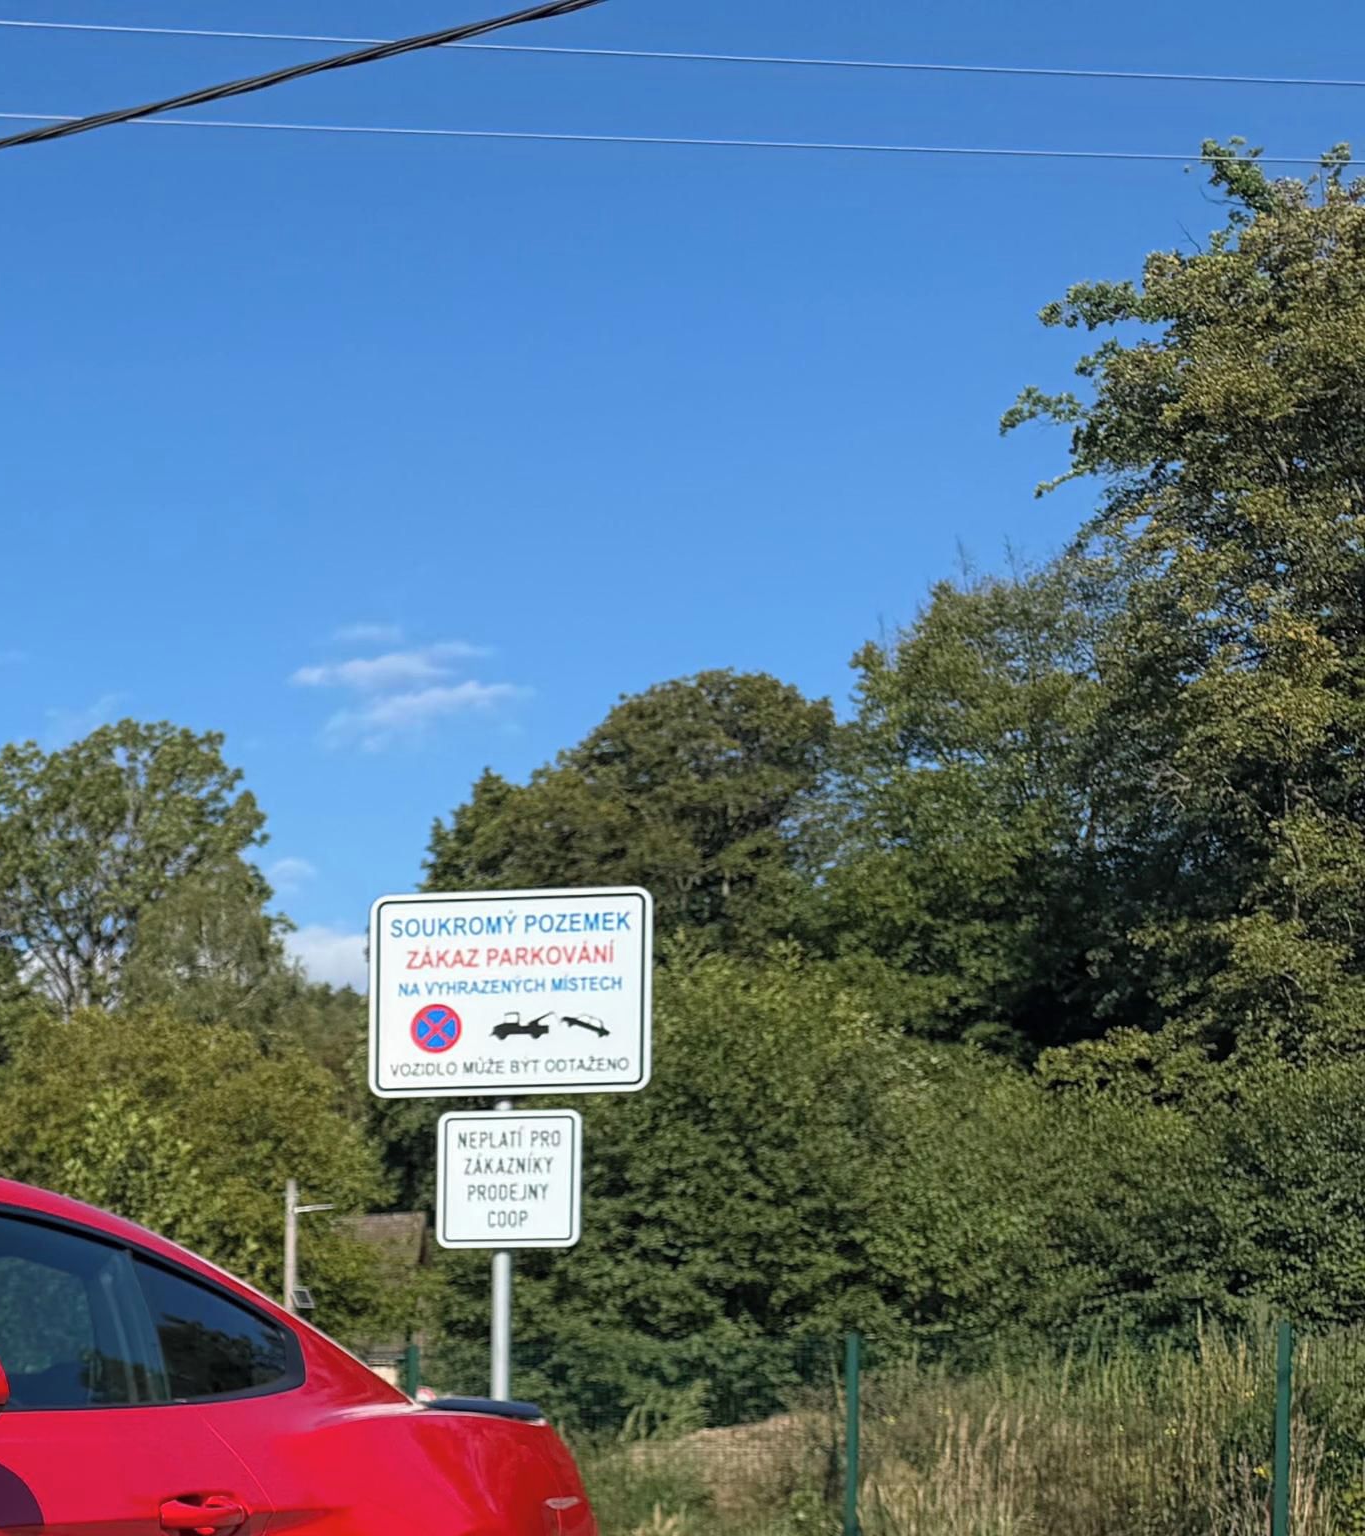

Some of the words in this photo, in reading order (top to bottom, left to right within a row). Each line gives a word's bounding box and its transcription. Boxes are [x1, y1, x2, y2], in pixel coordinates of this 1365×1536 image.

[390, 911, 517, 938] SOUKROMÝ
[524, 911, 631, 933] POZEMEK
[406, 944, 480, 970] ZÁKAZ
[486, 939, 615, 967] PARKOVÁNÍ
[398, 982, 420, 997] NA
[425, 976, 545, 996] VYHRAZENÝCH
[551, 974, 623, 993] MÍSTECH
[390, 1060, 458, 1077] VOZIDLO
[463, 1056, 505, 1074] MŮŽE
[510, 1055, 541, 1073] BÝT
[544, 1055, 630, 1072] ODTAŽENO
[457, 1126, 523, 1149] NEPLATÍ
[530, 1130, 561, 1147] PRO
[464, 1152, 554, 1175] ZÁKAZNÍKY
[467, 1183, 549, 1202] PRODEJNY
[487, 1210, 529, 1229] COOP
